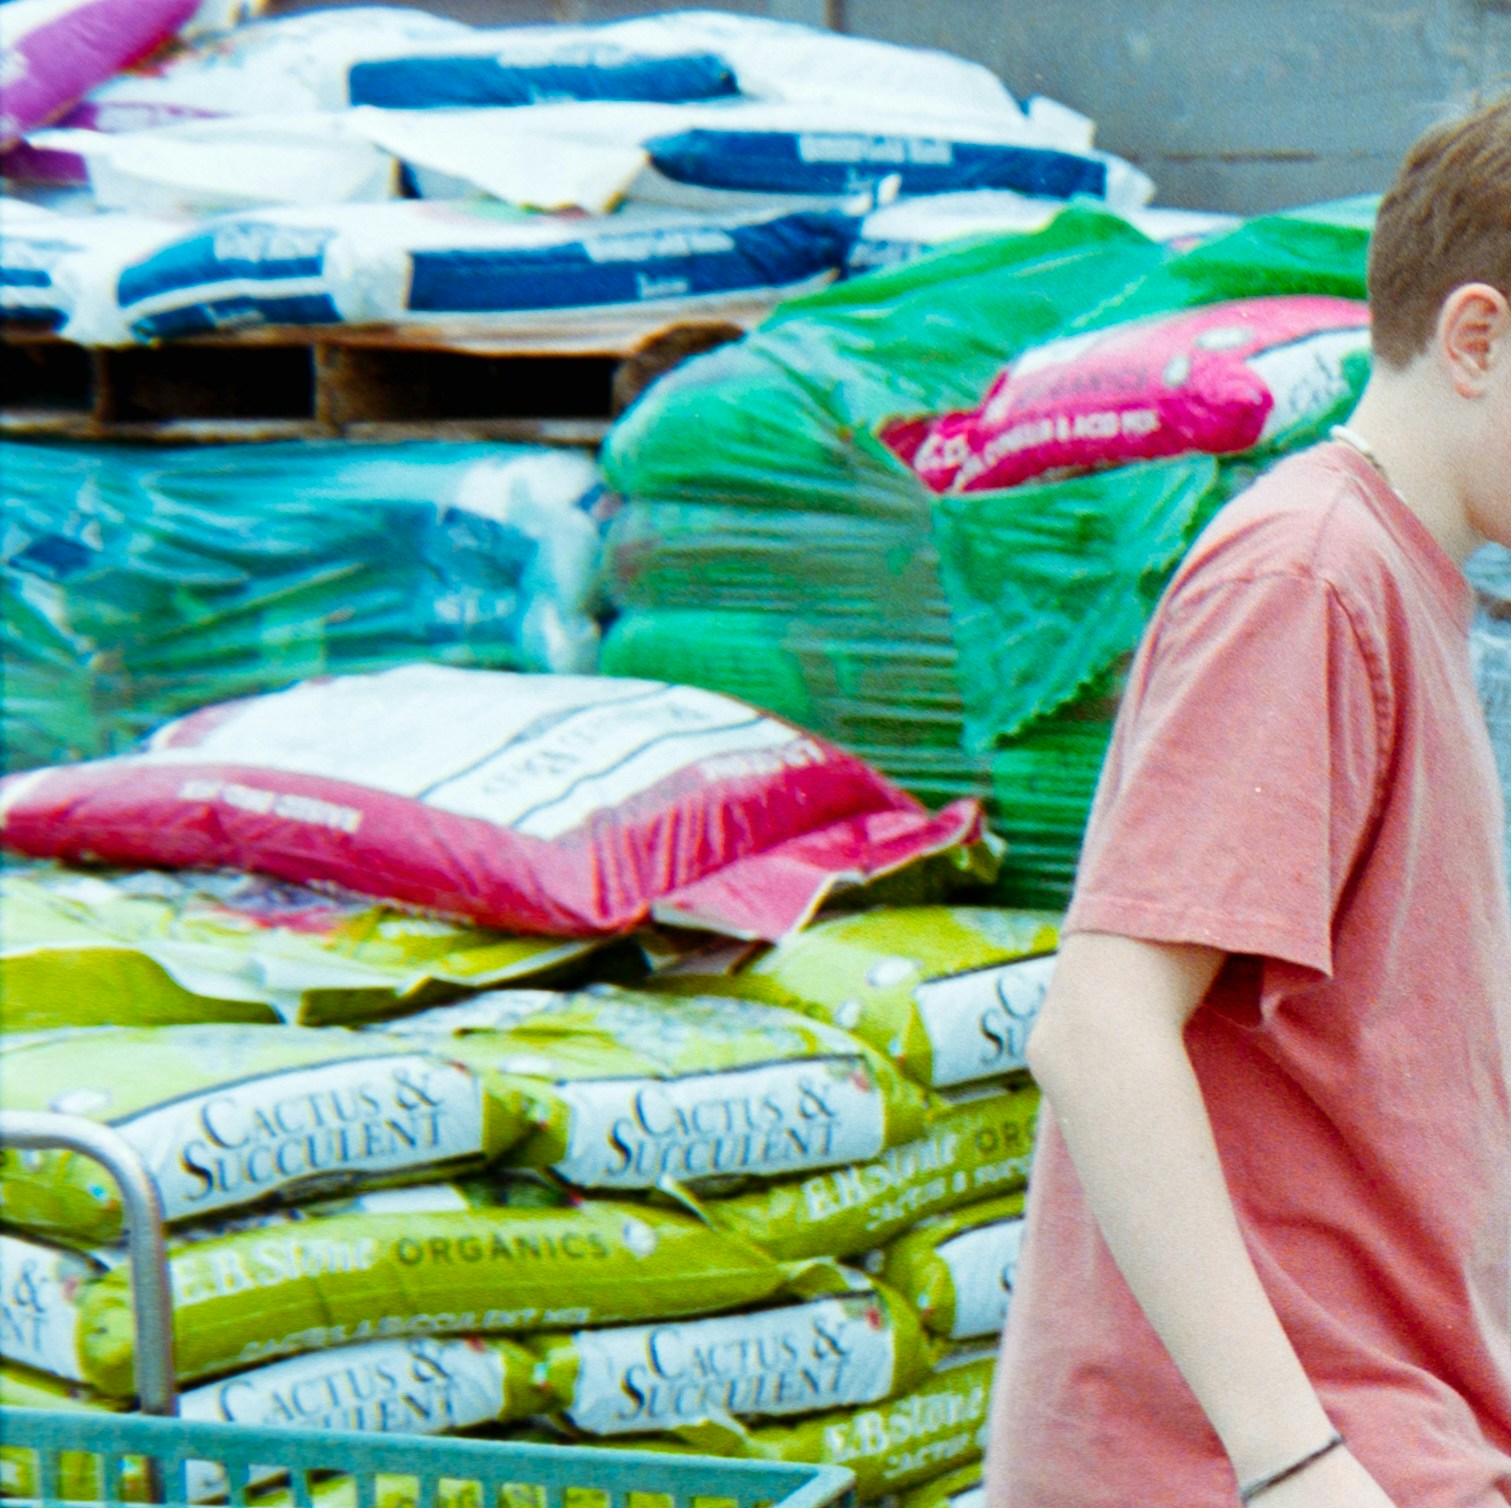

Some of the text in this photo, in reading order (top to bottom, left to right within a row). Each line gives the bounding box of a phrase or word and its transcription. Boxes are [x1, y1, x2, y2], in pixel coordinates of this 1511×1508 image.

[199, 1068, 443, 1149] CACTUS &
[634, 1076, 838, 1139] CACTUS &
[180, 1110, 443, 1199] SUCCULENT
[607, 1118, 838, 1177] SUCCULENT
[399, 1232, 609, 1268] ORGANICS
[216, 1339, 451, 1421] CACTUS &
[648, 1315, 849, 1381] CACTUS &
[615, 1362, 849, 1420] SUCCULENT
